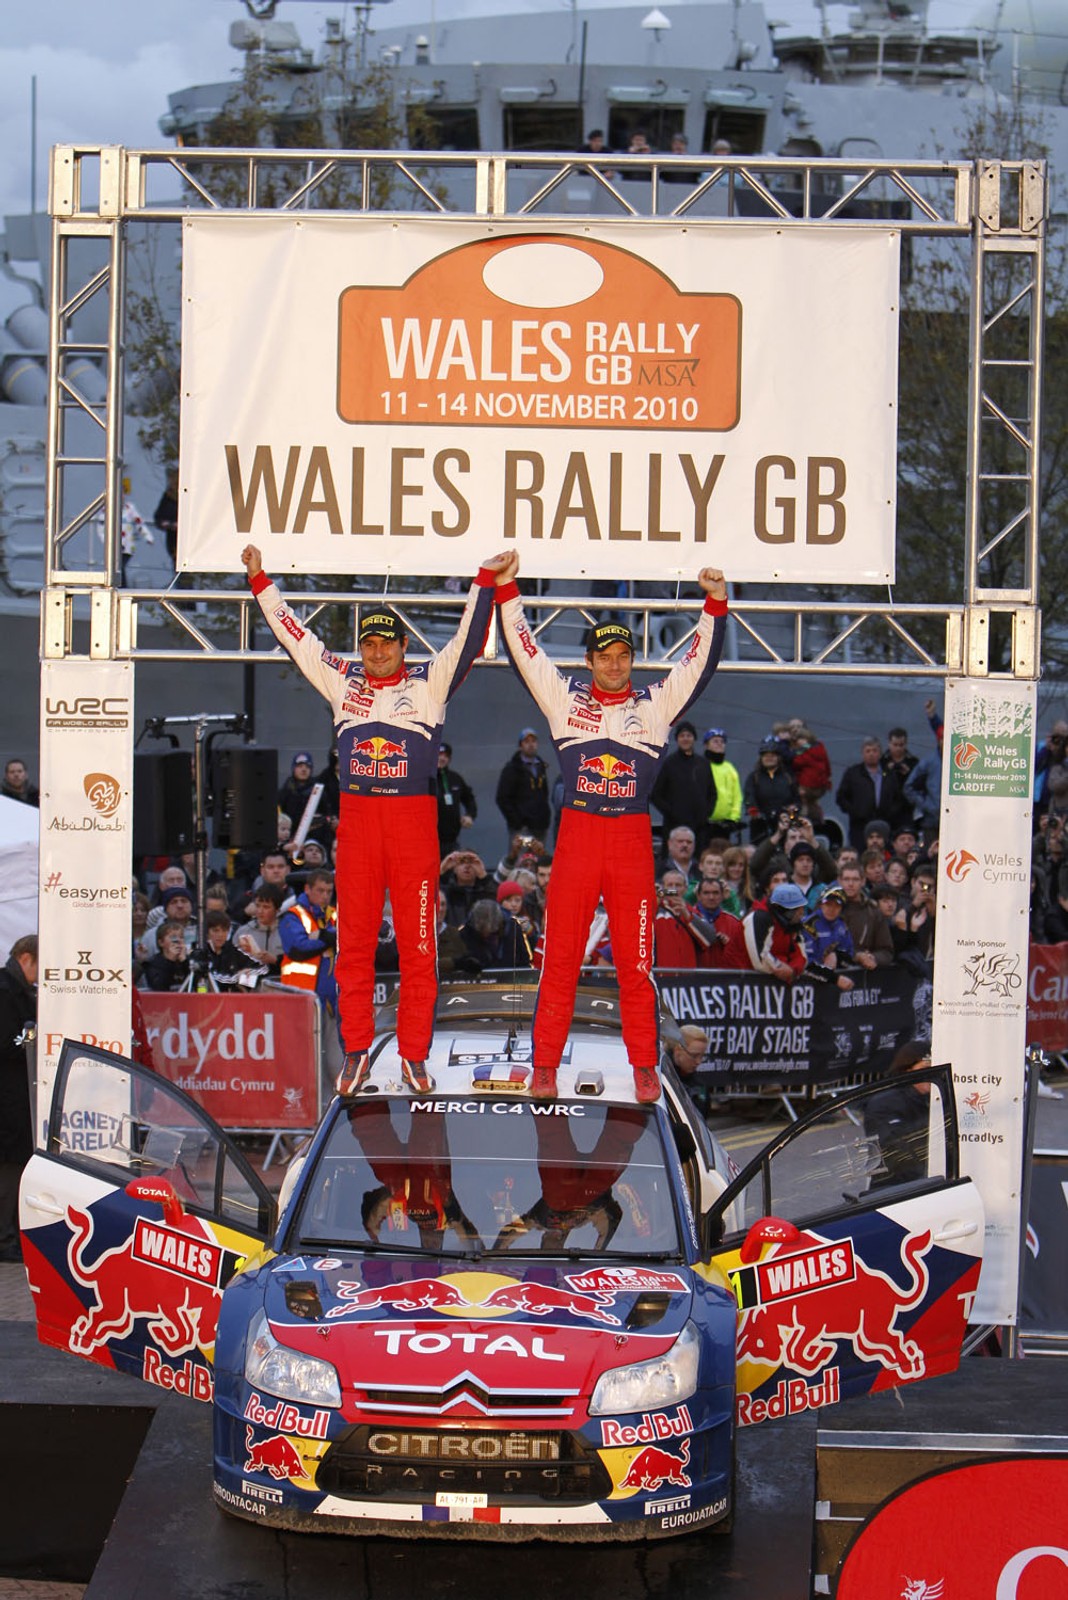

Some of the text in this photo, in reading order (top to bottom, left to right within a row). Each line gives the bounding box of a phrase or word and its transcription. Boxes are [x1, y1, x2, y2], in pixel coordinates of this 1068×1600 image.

[381, 317, 700, 382] WALES RALLY
[585, 354, 698, 386] GB MSA
[381, 391, 407, 415] 11
[437, 392, 468, 417] 14
[475, 393, 626, 419] NOVEMBER
[633, 396, 698, 421] 2010
[225, 445, 847, 545] WALES RALLY GB
[283, 616, 304, 640] TOTAL
[46, 698, 128, 715] WRC
[579, 710, 601, 721] TOTAL
[567, 717, 600, 734] PIRELLI
[984, 744, 1018, 757] Wales
[350, 759, 408, 778] Red Bull
[983, 757, 1027, 772] Rally GB
[973, 773, 1010, 781] November
[576, 775, 637, 798] Red Bull
[952, 782, 996, 793] CARDIFF
[983, 853, 1023, 867] Wales
[983, 868, 1027, 884] Cymru
[59, 886, 127, 902] easynet
[956, 939, 1007, 950] Main Sponsor
[44, 968, 125, 982] EDOX
[50, 984, 118, 995] Swiss Watches
[729, 984, 785, 1020] RALLY
[791, 984, 815, 1020] GB
[727, 1026, 758, 1054] BAY
[762, 1025, 811, 1054] STAGE
[230, 1077, 275, 1095] Cymru
[953, 1073, 1003, 1087] host city
[410, 1101, 586, 1117] MERCI C4 WRC
[958, 1132, 1004, 1145] ncadlys
[136, 1186, 169, 1197] TOTAL
[140, 1227, 213, 1278] WALES
[766, 1248, 848, 1296] WALES
[572, 1275, 642, 1288] WALES
[373, 1329, 565, 1362] TOTAL
[143, 1346, 191, 1396] Red
[736, 1366, 840, 1427] Red Bull
[244, 1392, 331, 1440] Red Bull
[600, 1404, 694, 1447] Red Bull
[366, 1464, 558, 1480] RACING
[241, 1479, 283, 1504] PIRELLI
[644, 1493, 692, 1515] PIRELLI
[661, 1497, 728, 1530] EURODATACAR
